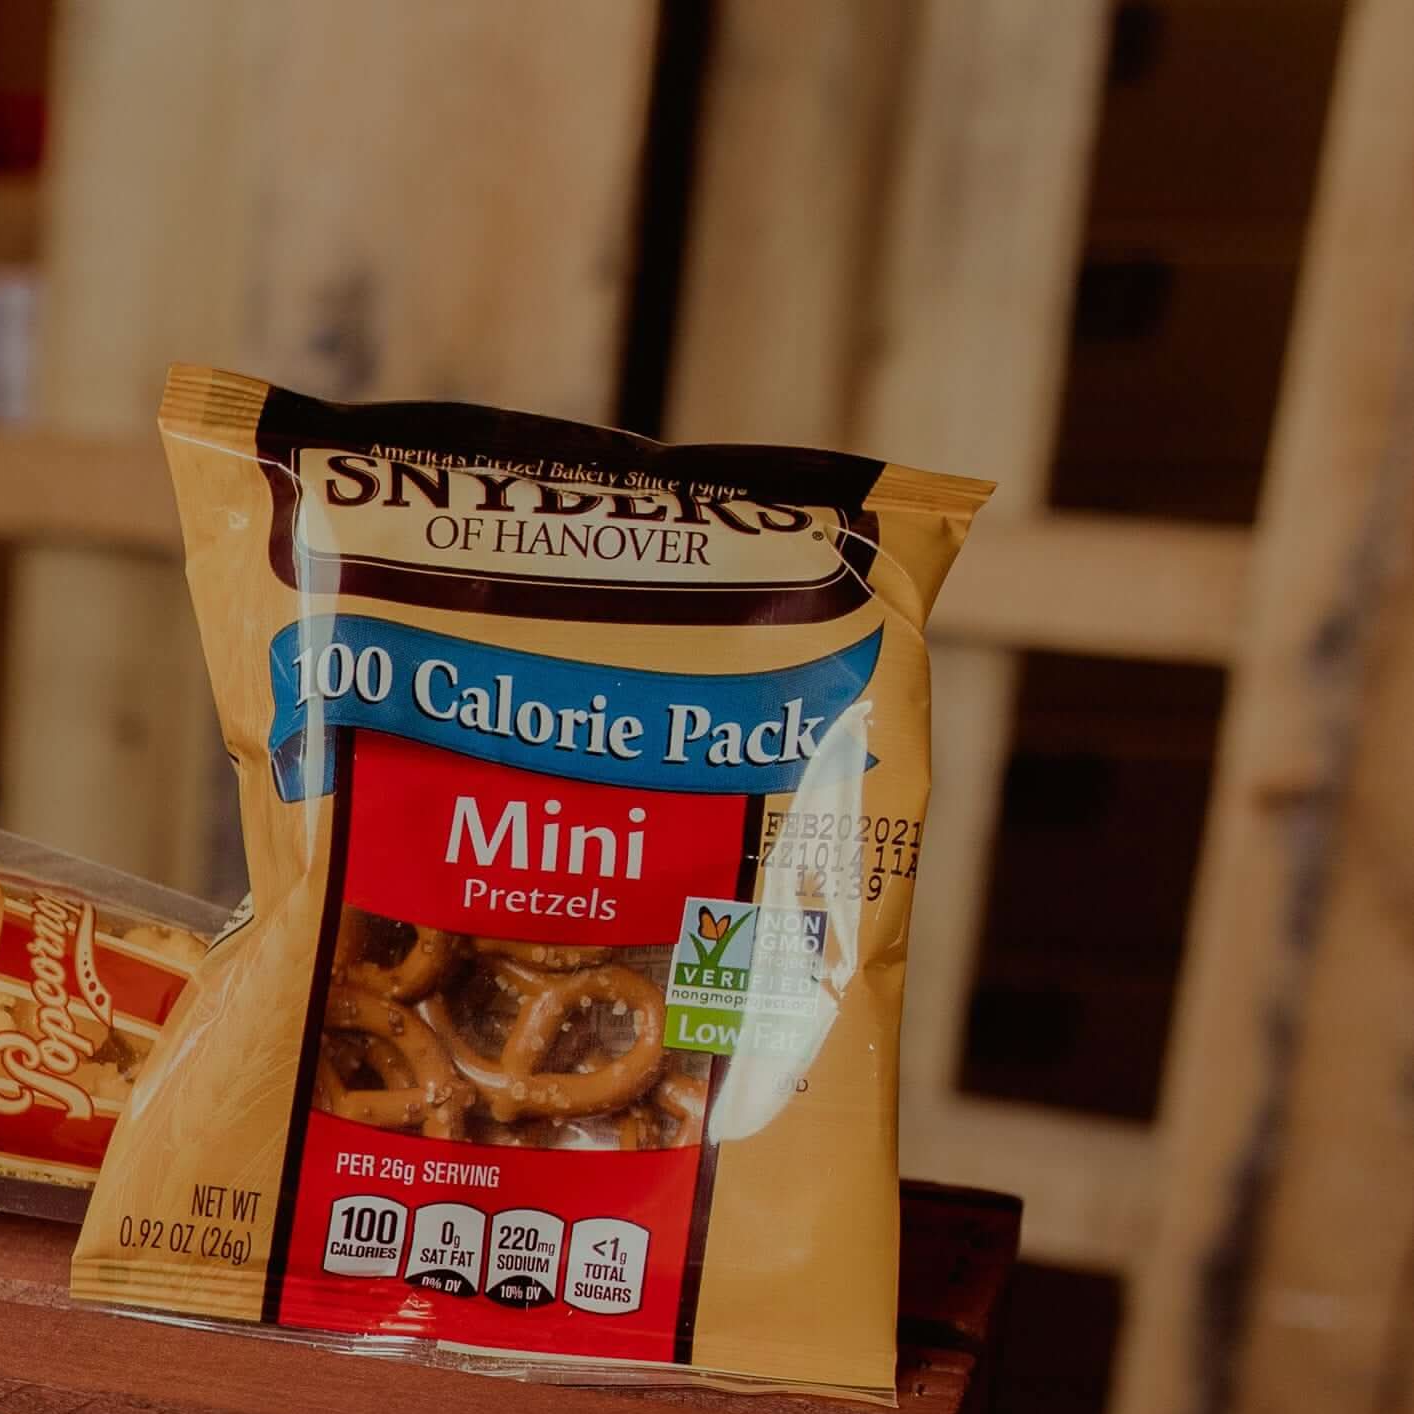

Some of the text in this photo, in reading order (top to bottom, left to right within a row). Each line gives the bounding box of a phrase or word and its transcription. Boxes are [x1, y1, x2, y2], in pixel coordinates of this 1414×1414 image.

[425, 514, 712, 567] OF HANOVER
[292, 642, 825, 768] 100 Calorie Pack
[445, 796, 647, 881] Mini
[462, 878, 618, 922] Pretzels
[762, 911, 820, 934] NON
[760, 935, 819, 954] GMO
[684, 967, 812, 994] VERIFIED
[678, 1013, 805, 1050] Low Fat
[336, 1152, 501, 1188] PER 26g SERVING
[191, 1183, 262, 1224] NET WT
[340, 1205, 398, 1245] 100
[440, 1220, 461, 1249] 0g
[119, 1215, 253, 1266] 0.92 OZ (26g)
[330, 1241, 397, 1260] CALORIES
[498, 1224, 556, 1257] 220mg
[592, 1236, 628, 1266] <1g
[420, 1248, 476, 1269] SAT FAT
[497, 1253, 550, 1274] SODIUM
[583, 1262, 627, 1283] TOTAL
[445, 1279, 462, 1294] DV
[500, 1285, 542, 1302] 10% DV
[574, 1281, 632, 1303] SUGARS
